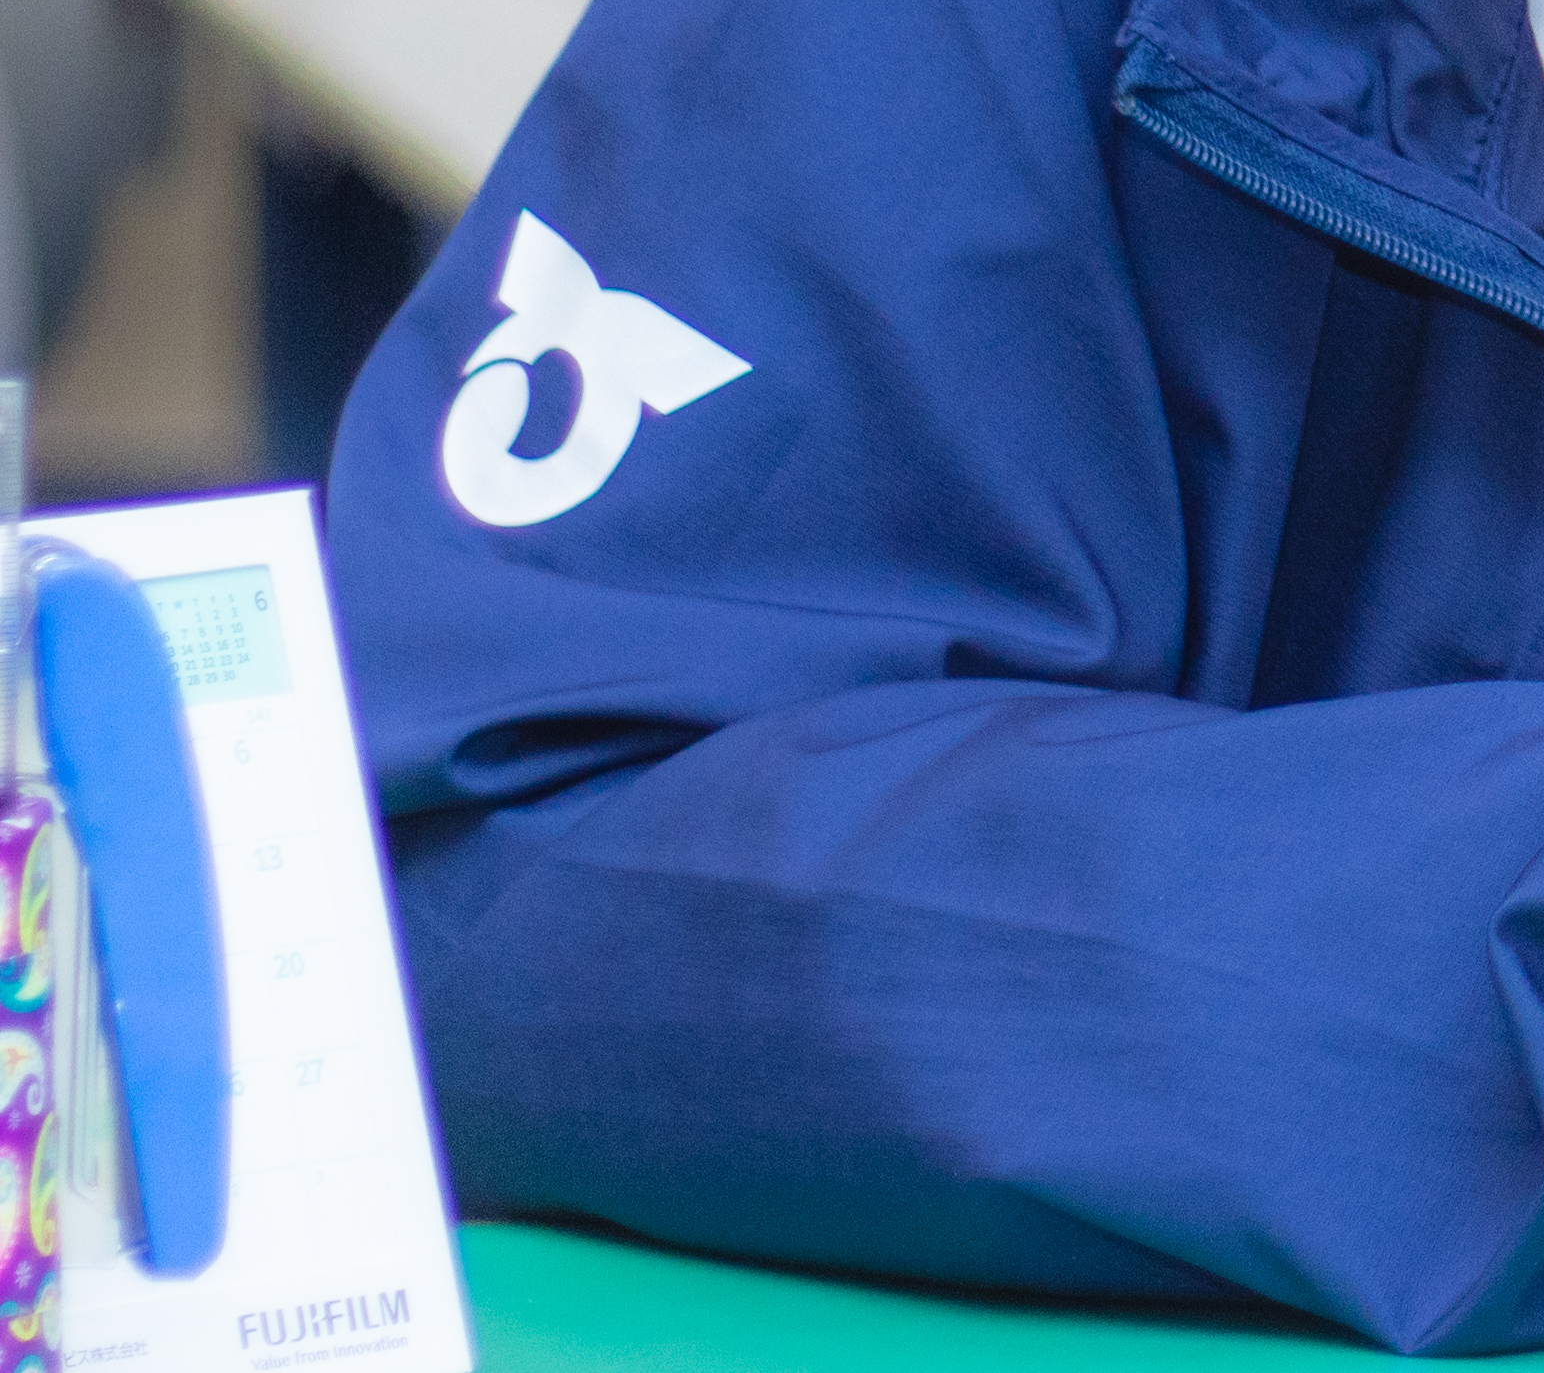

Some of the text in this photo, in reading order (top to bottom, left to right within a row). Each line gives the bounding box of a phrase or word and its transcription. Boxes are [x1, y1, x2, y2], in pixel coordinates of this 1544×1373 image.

[253, 590, 268, 612] 6
[233, 738, 252, 765] 6
[251, 844, 285, 872] 13
[272, 951, 307, 981] 20
[292, 1058, 326, 1088] 27
[237, 1288, 412, 1350] FUJIFILM
[251, 1334, 410, 1372] Value from Innovation
